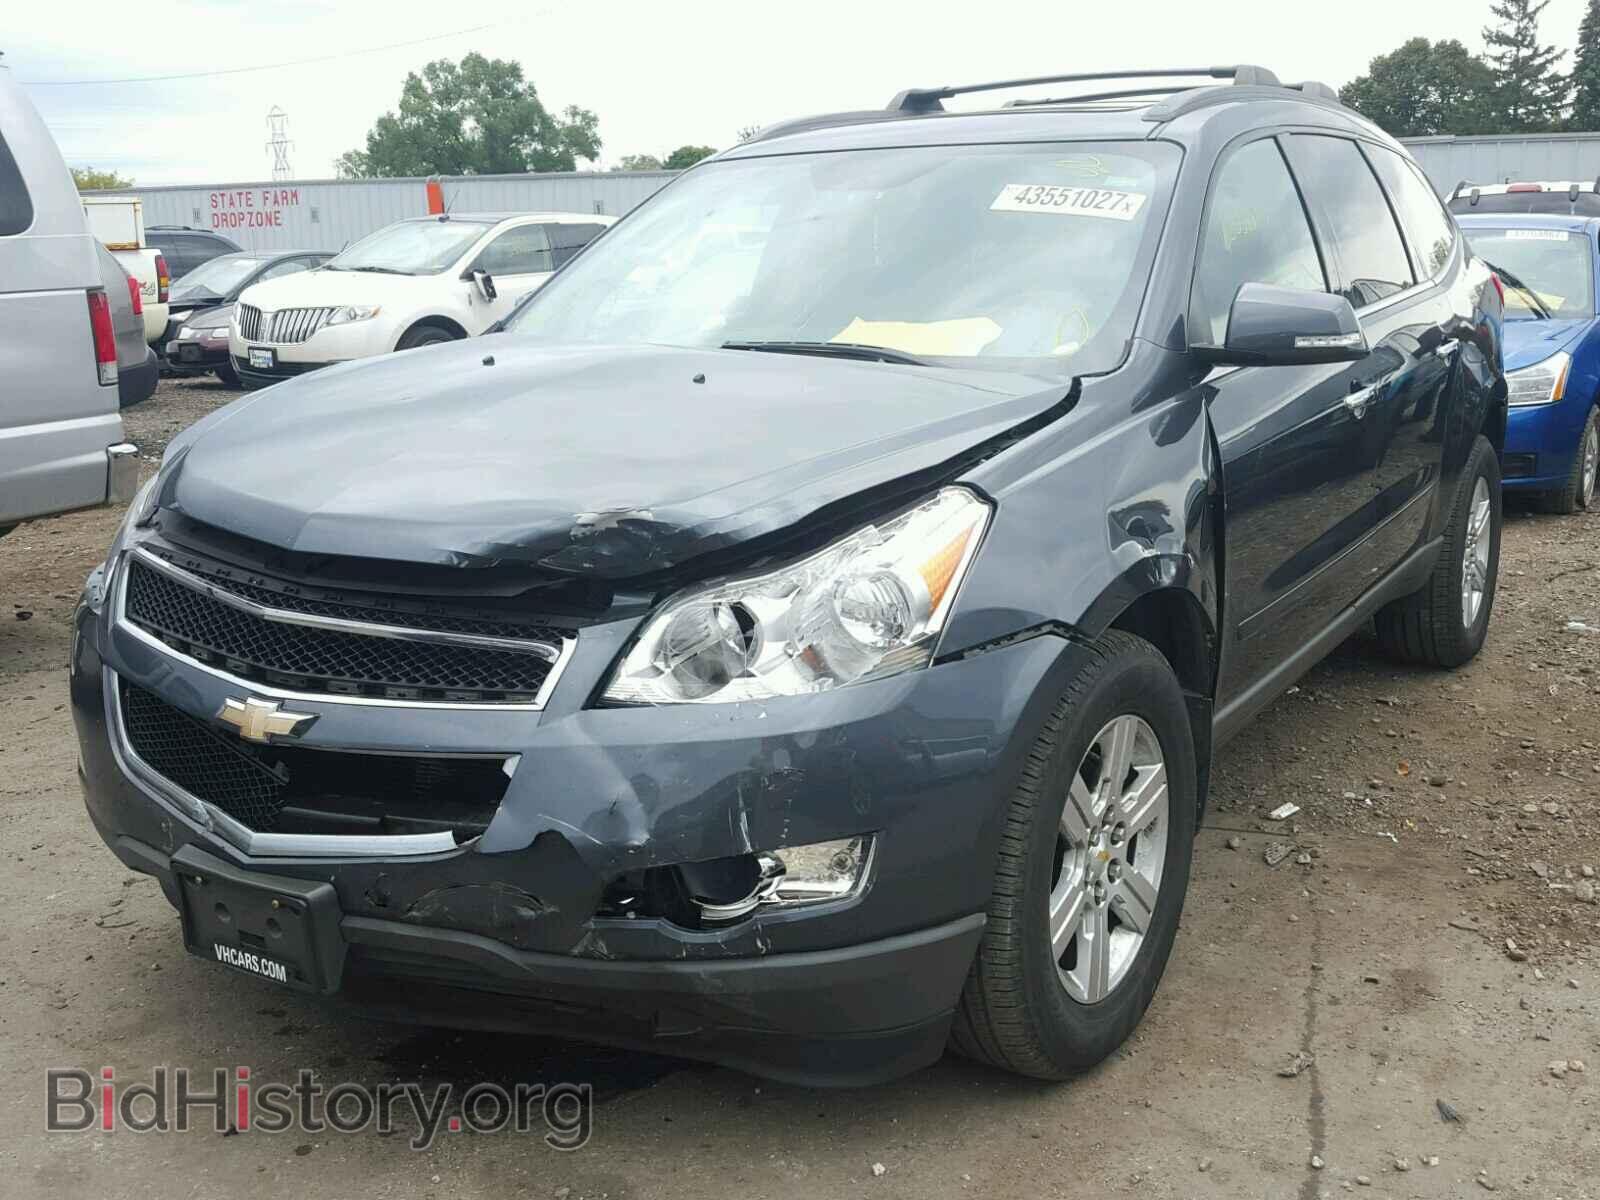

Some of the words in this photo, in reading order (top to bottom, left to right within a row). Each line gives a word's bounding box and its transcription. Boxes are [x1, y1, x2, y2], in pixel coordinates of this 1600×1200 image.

[210, 191, 254, 209] STATE
[262, 189, 300, 206] FARM
[212, 210, 283, 228] DROPZONE
[214, 943, 287, 983] VHCARS.COM
